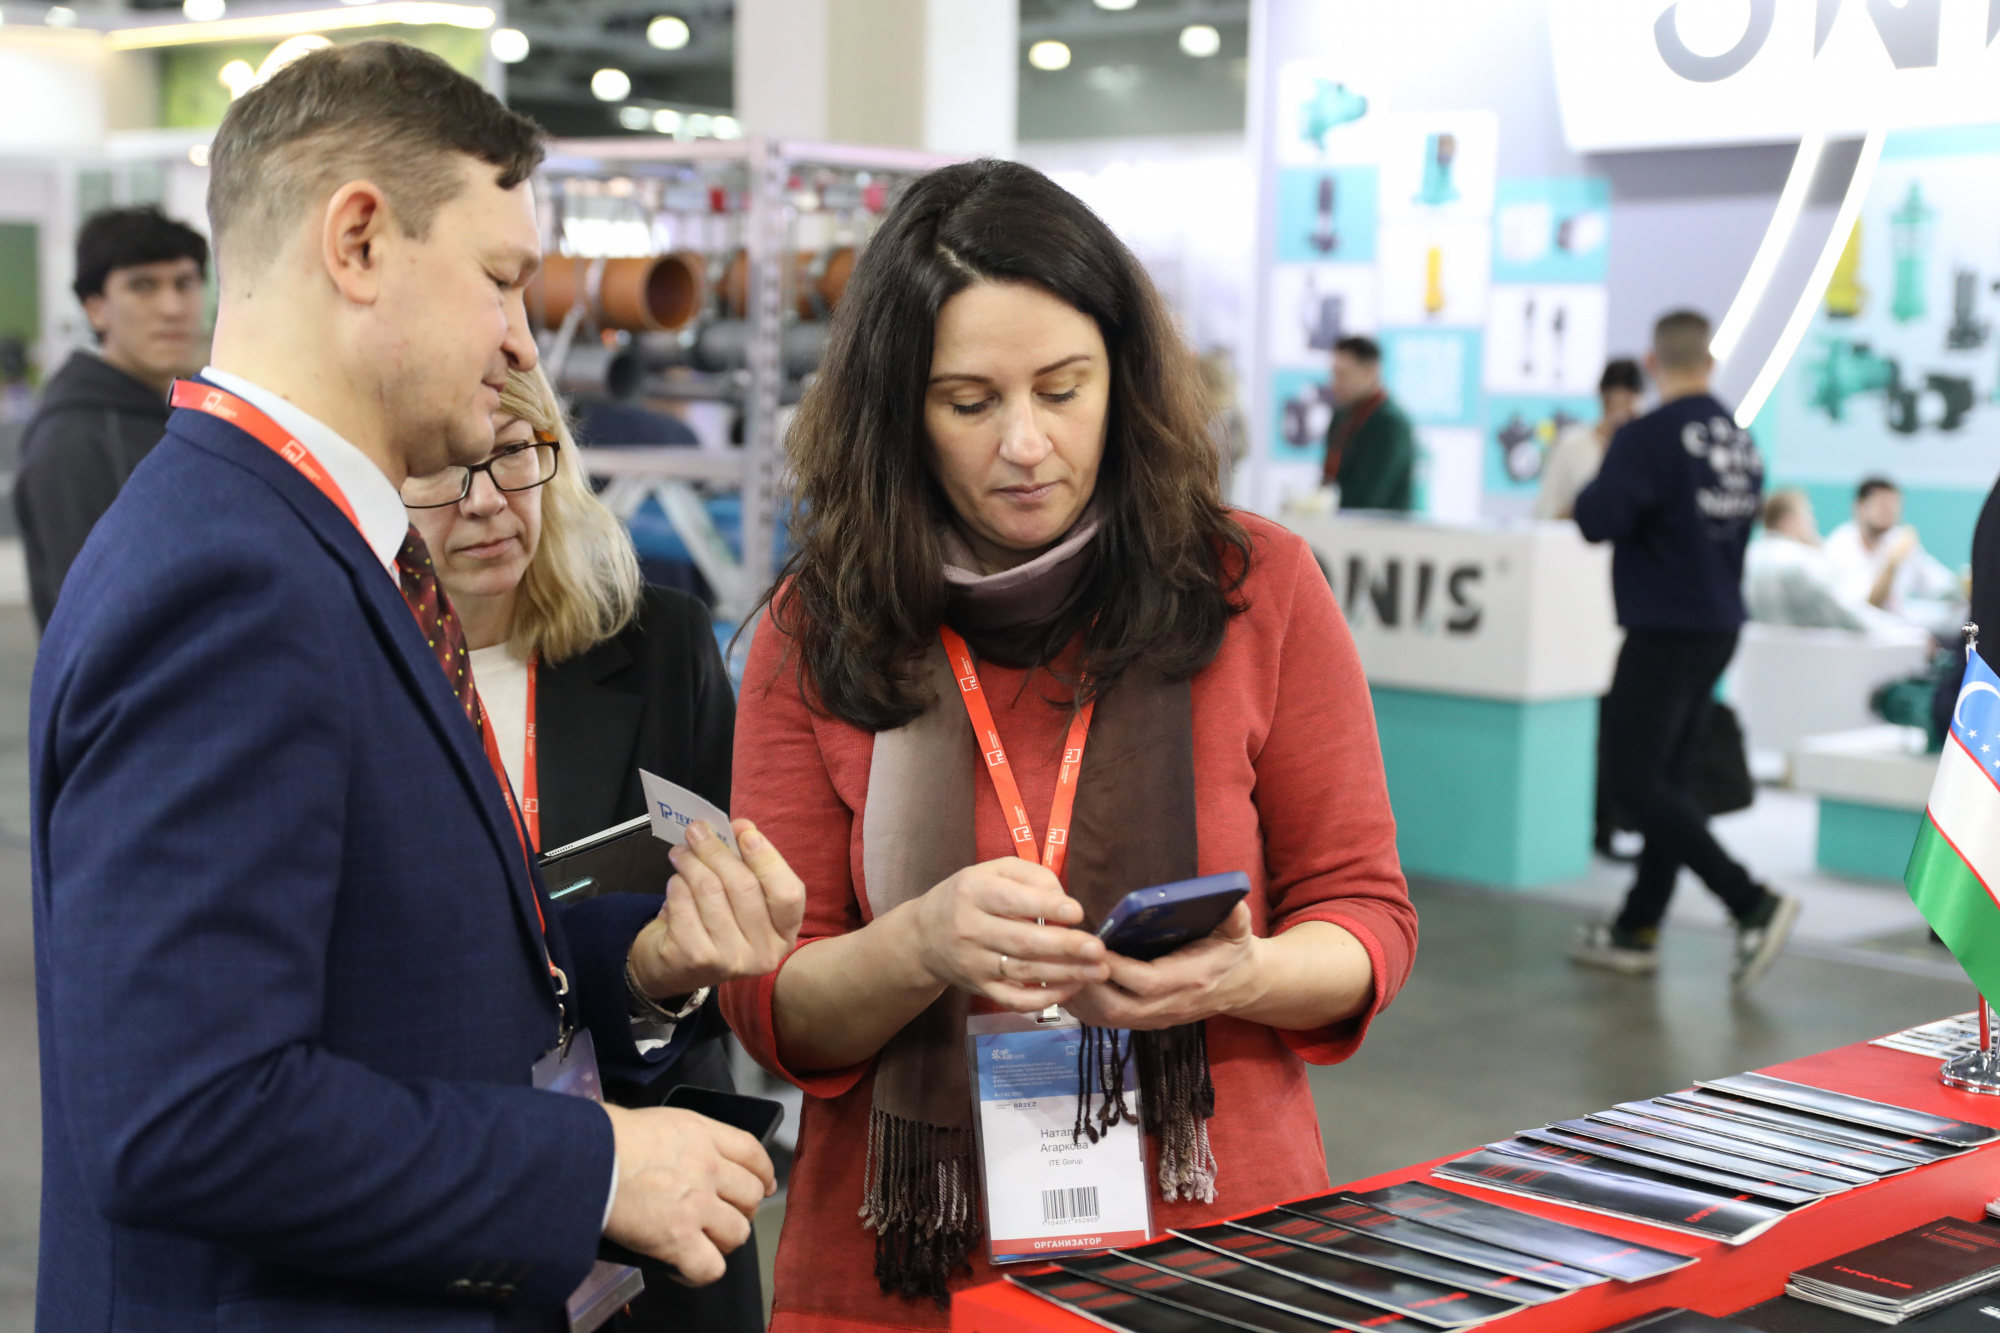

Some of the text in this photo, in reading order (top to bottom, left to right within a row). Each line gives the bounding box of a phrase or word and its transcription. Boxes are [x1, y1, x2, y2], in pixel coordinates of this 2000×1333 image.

[1310, 545, 1484, 634] NIS
[1040, 1128, 1087, 1138] Наталя
[1040, 1141, 1089, 1153] Агаркова
[1034, 1237, 1102, 1249] ОРГАНИЗАТОР
